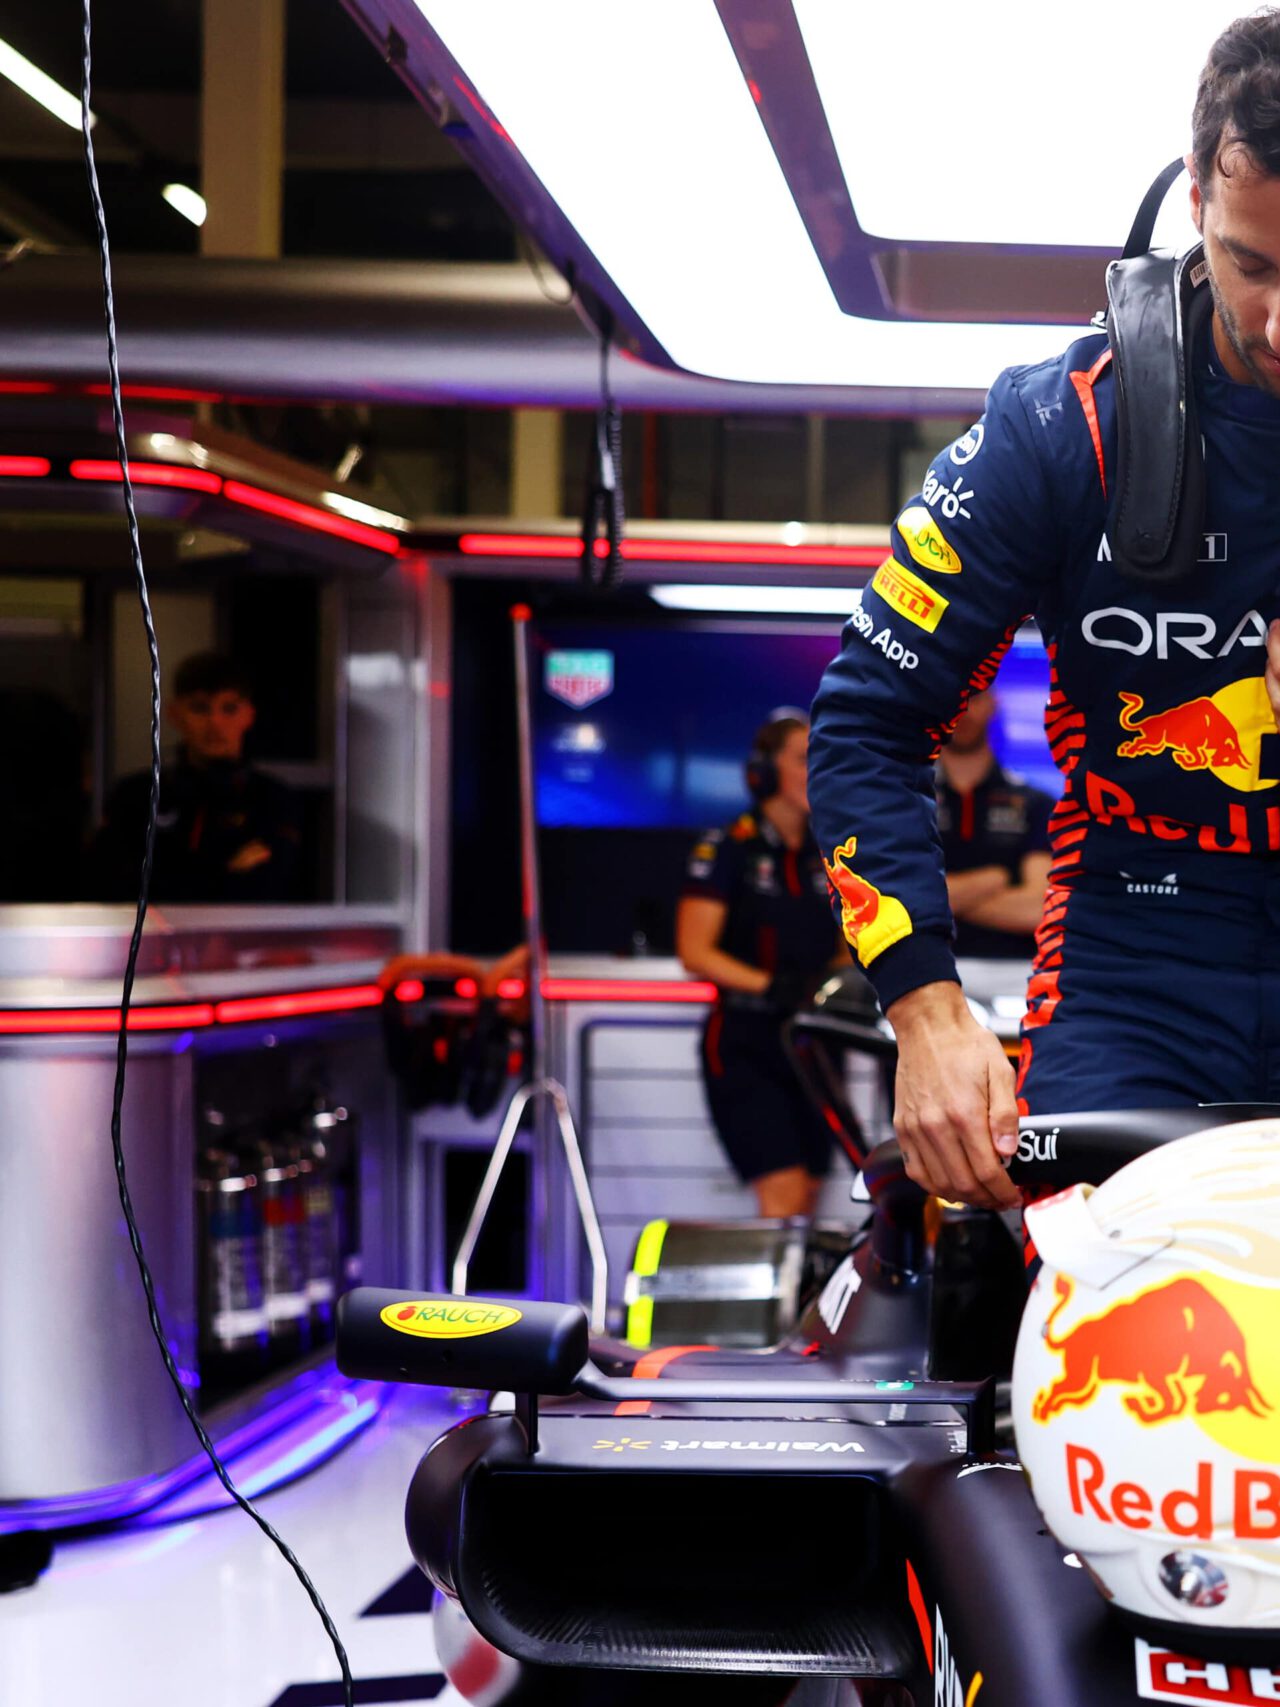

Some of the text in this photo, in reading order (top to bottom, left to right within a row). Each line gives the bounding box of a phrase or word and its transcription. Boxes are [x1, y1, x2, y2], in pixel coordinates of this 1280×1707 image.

[914, 531, 952, 567] UCH
[871, 628, 919, 670] App
[1086, 768, 1251, 854] Red
[1127, 884, 1180, 896] CASTORE
[1016, 1127, 1060, 1162] Sui
[415, 1306, 503, 1324] RAUCH
[660, 1438, 865, 1453] Walmart
[1065, 1442, 1213, 1541] Red
